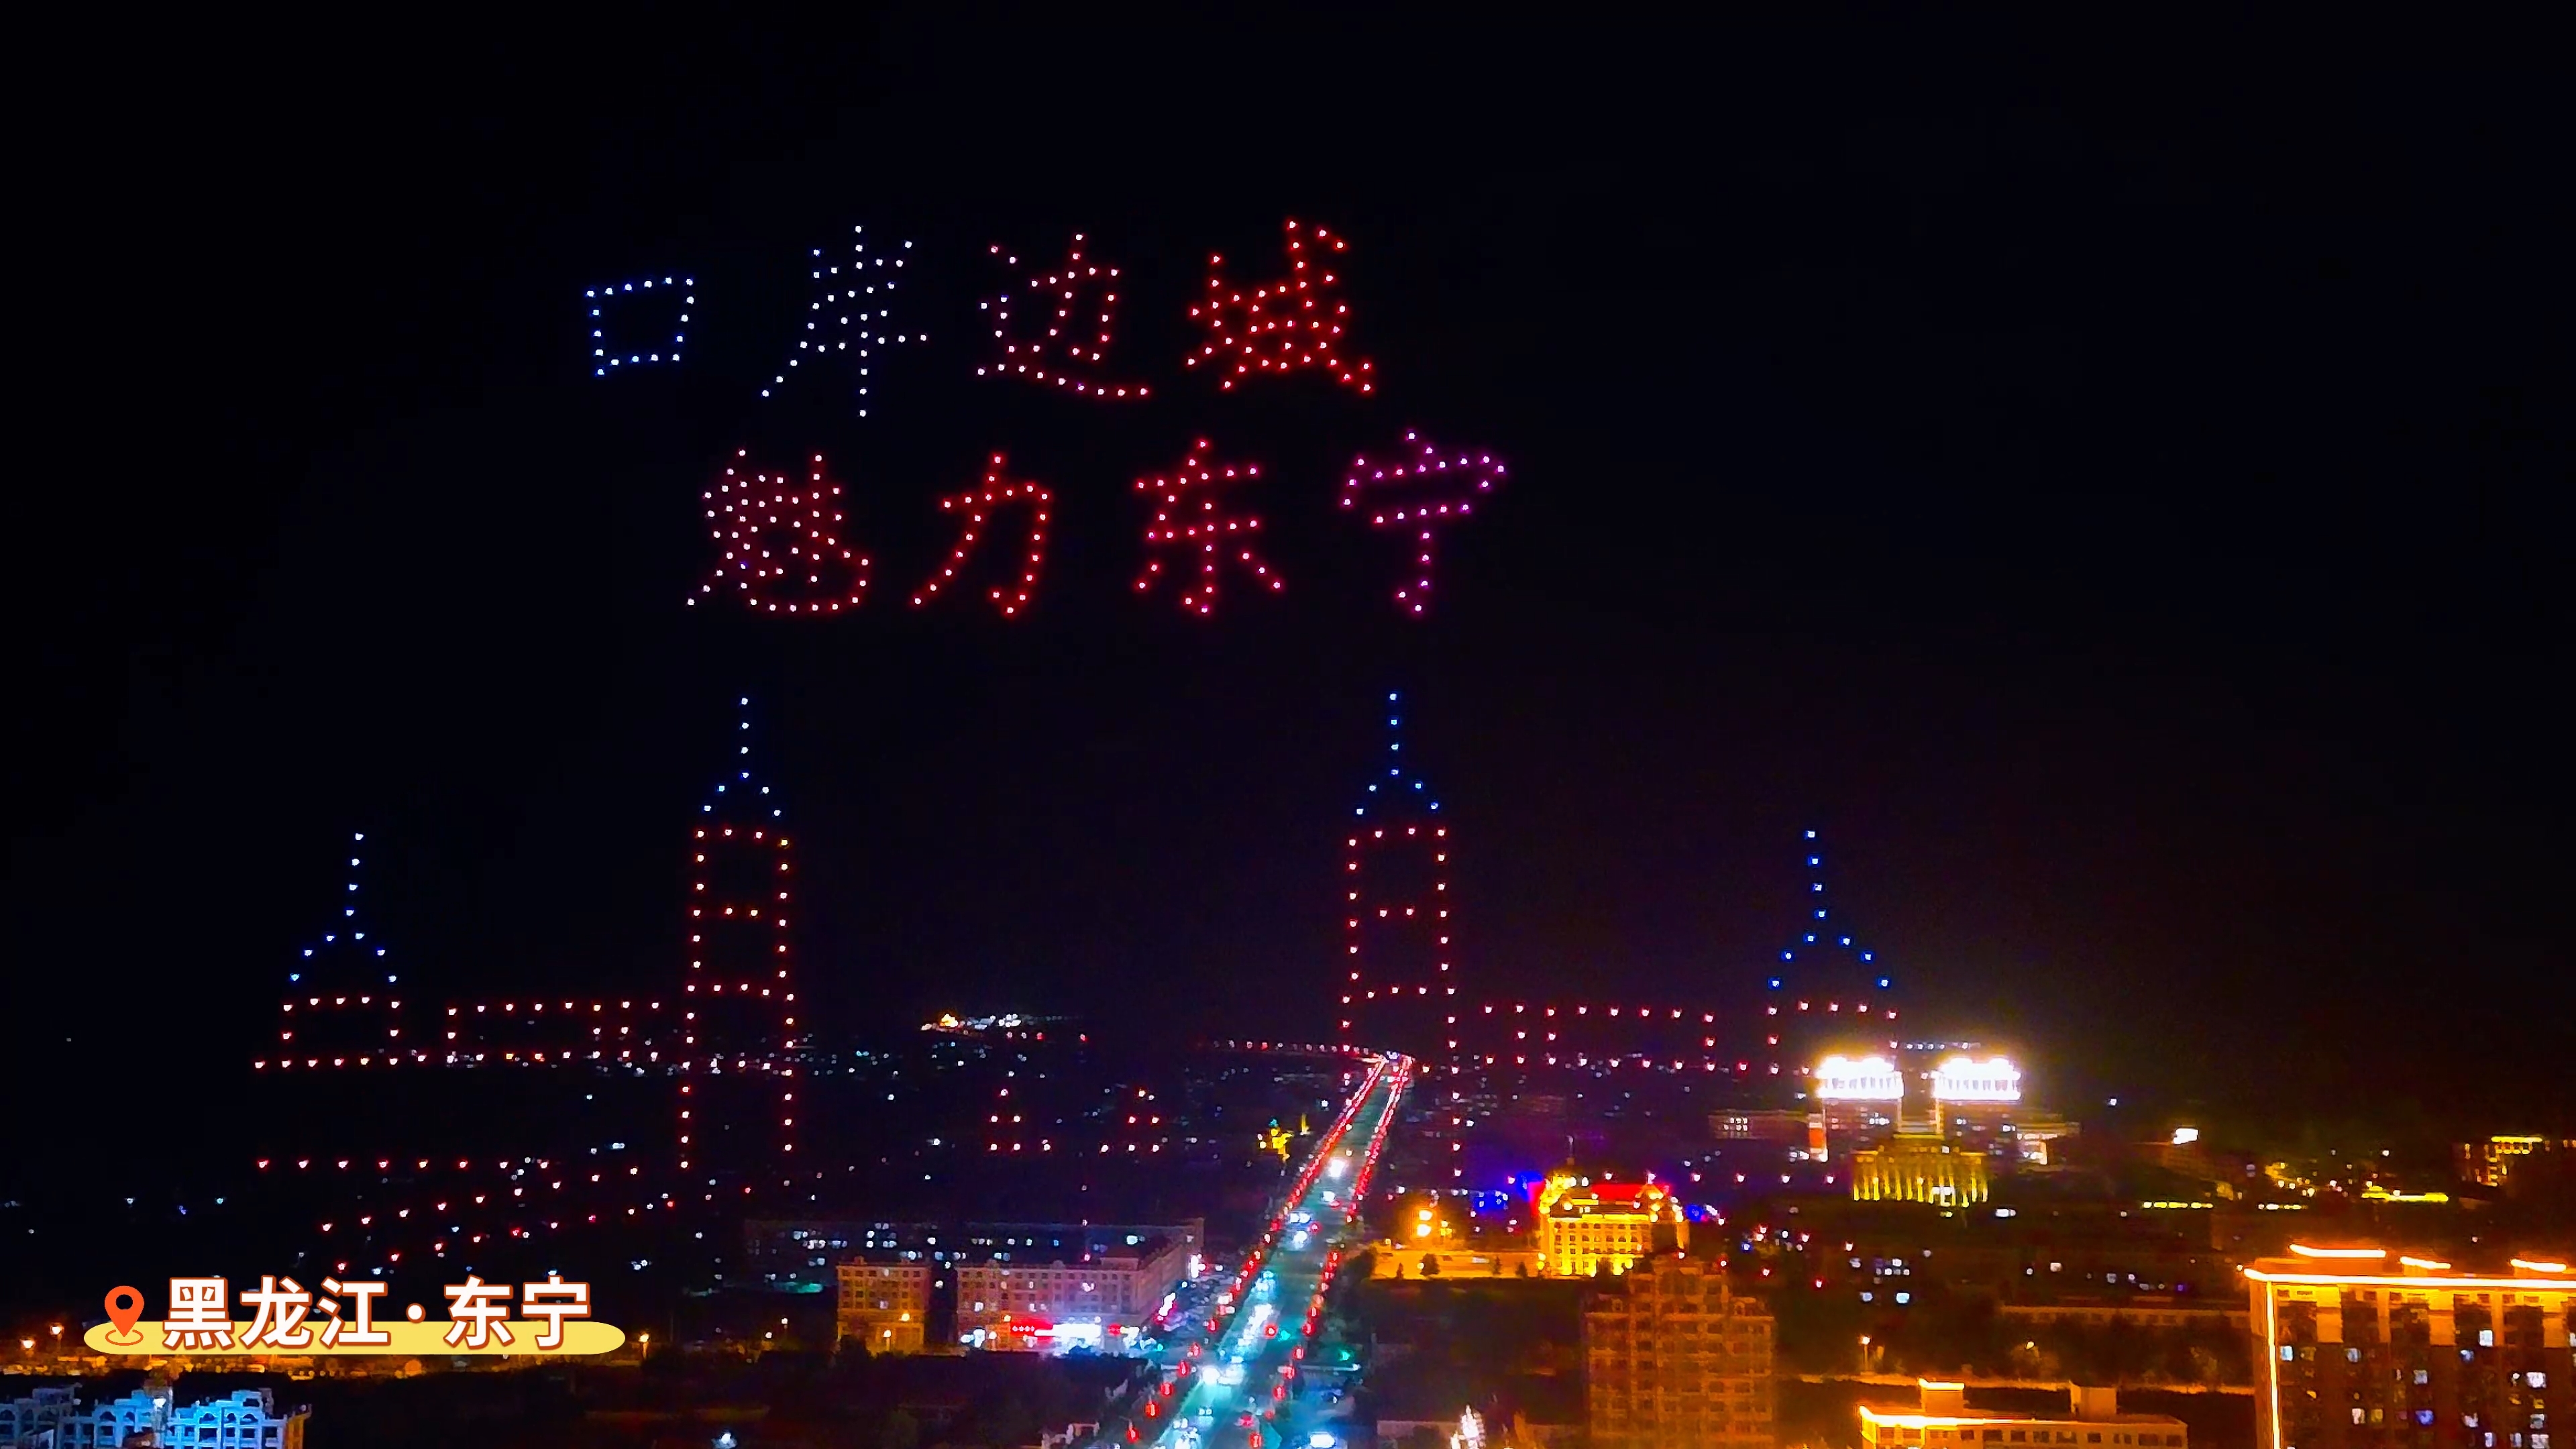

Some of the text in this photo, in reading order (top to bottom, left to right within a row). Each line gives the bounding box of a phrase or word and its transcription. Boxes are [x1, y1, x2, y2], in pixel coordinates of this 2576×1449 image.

[585, 221, 1373, 417] 口岸边城
[687, 433, 1505, 615] 魅力东宁
